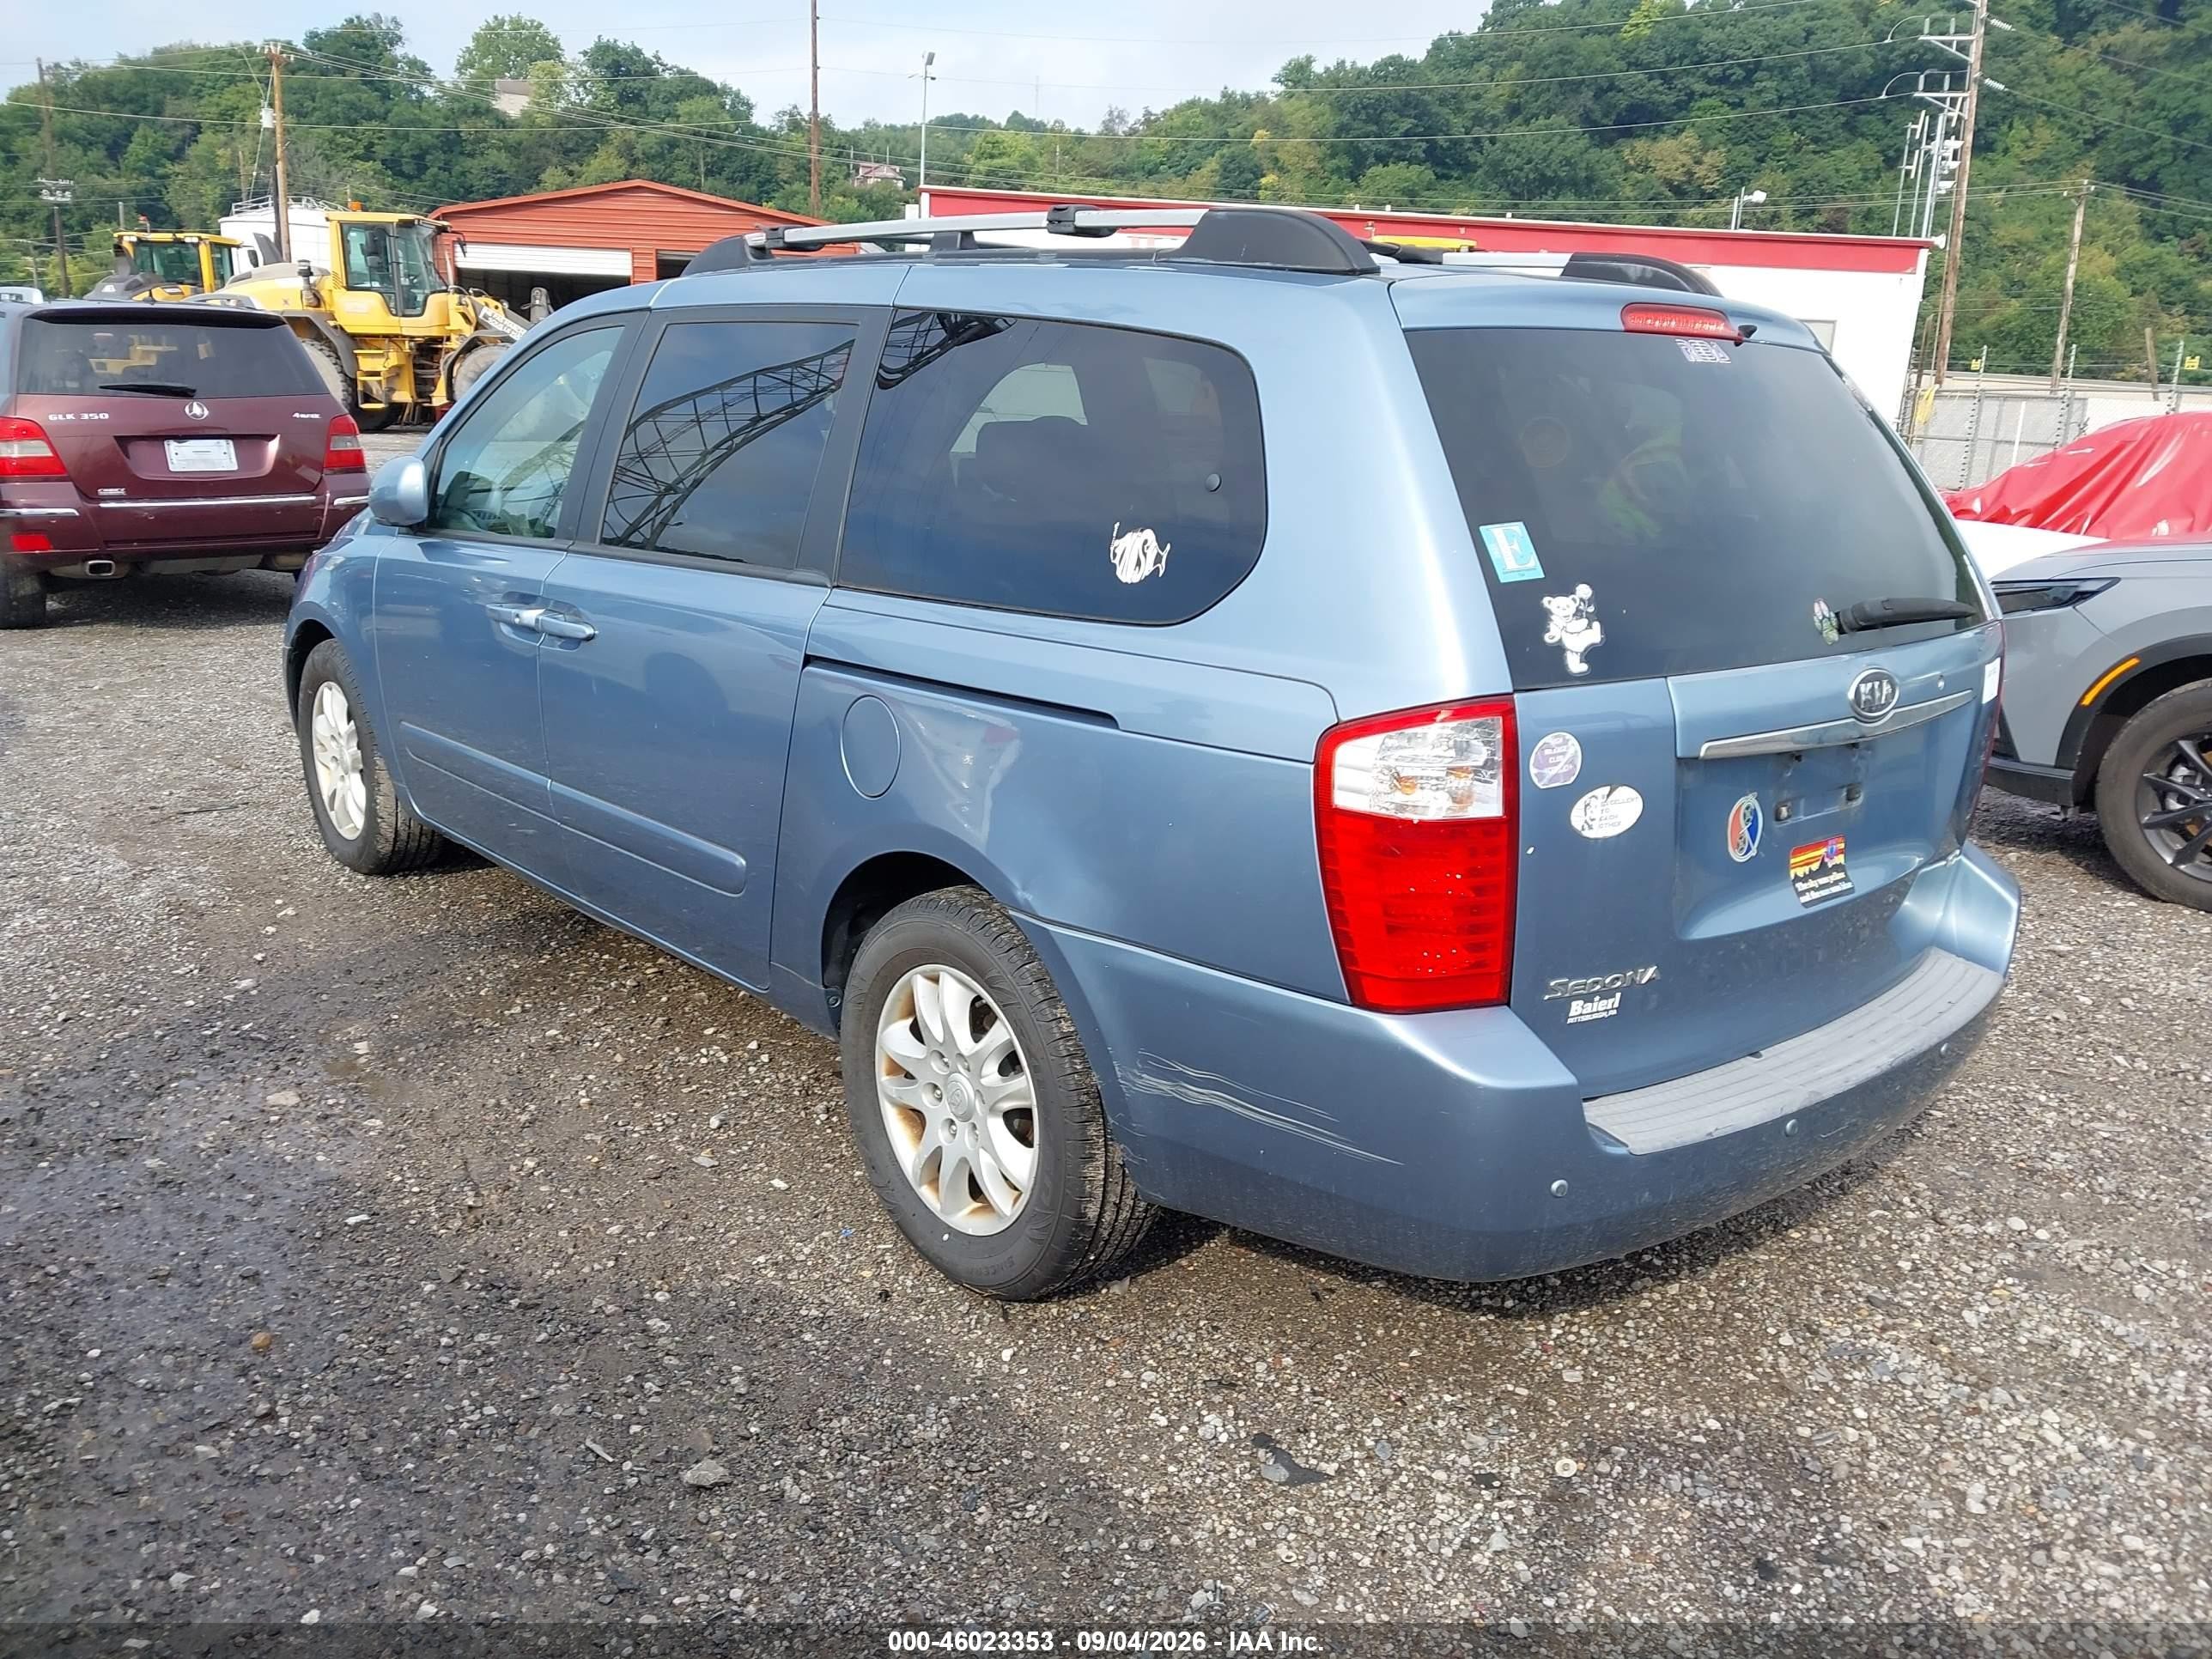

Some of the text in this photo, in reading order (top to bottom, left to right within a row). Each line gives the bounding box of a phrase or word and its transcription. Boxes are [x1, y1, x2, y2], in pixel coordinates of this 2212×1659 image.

[1858, 679, 1893, 708] KIA
[1543, 965, 1662, 1000] SEDONA
[1568, 992, 1622, 1017] Baierl
